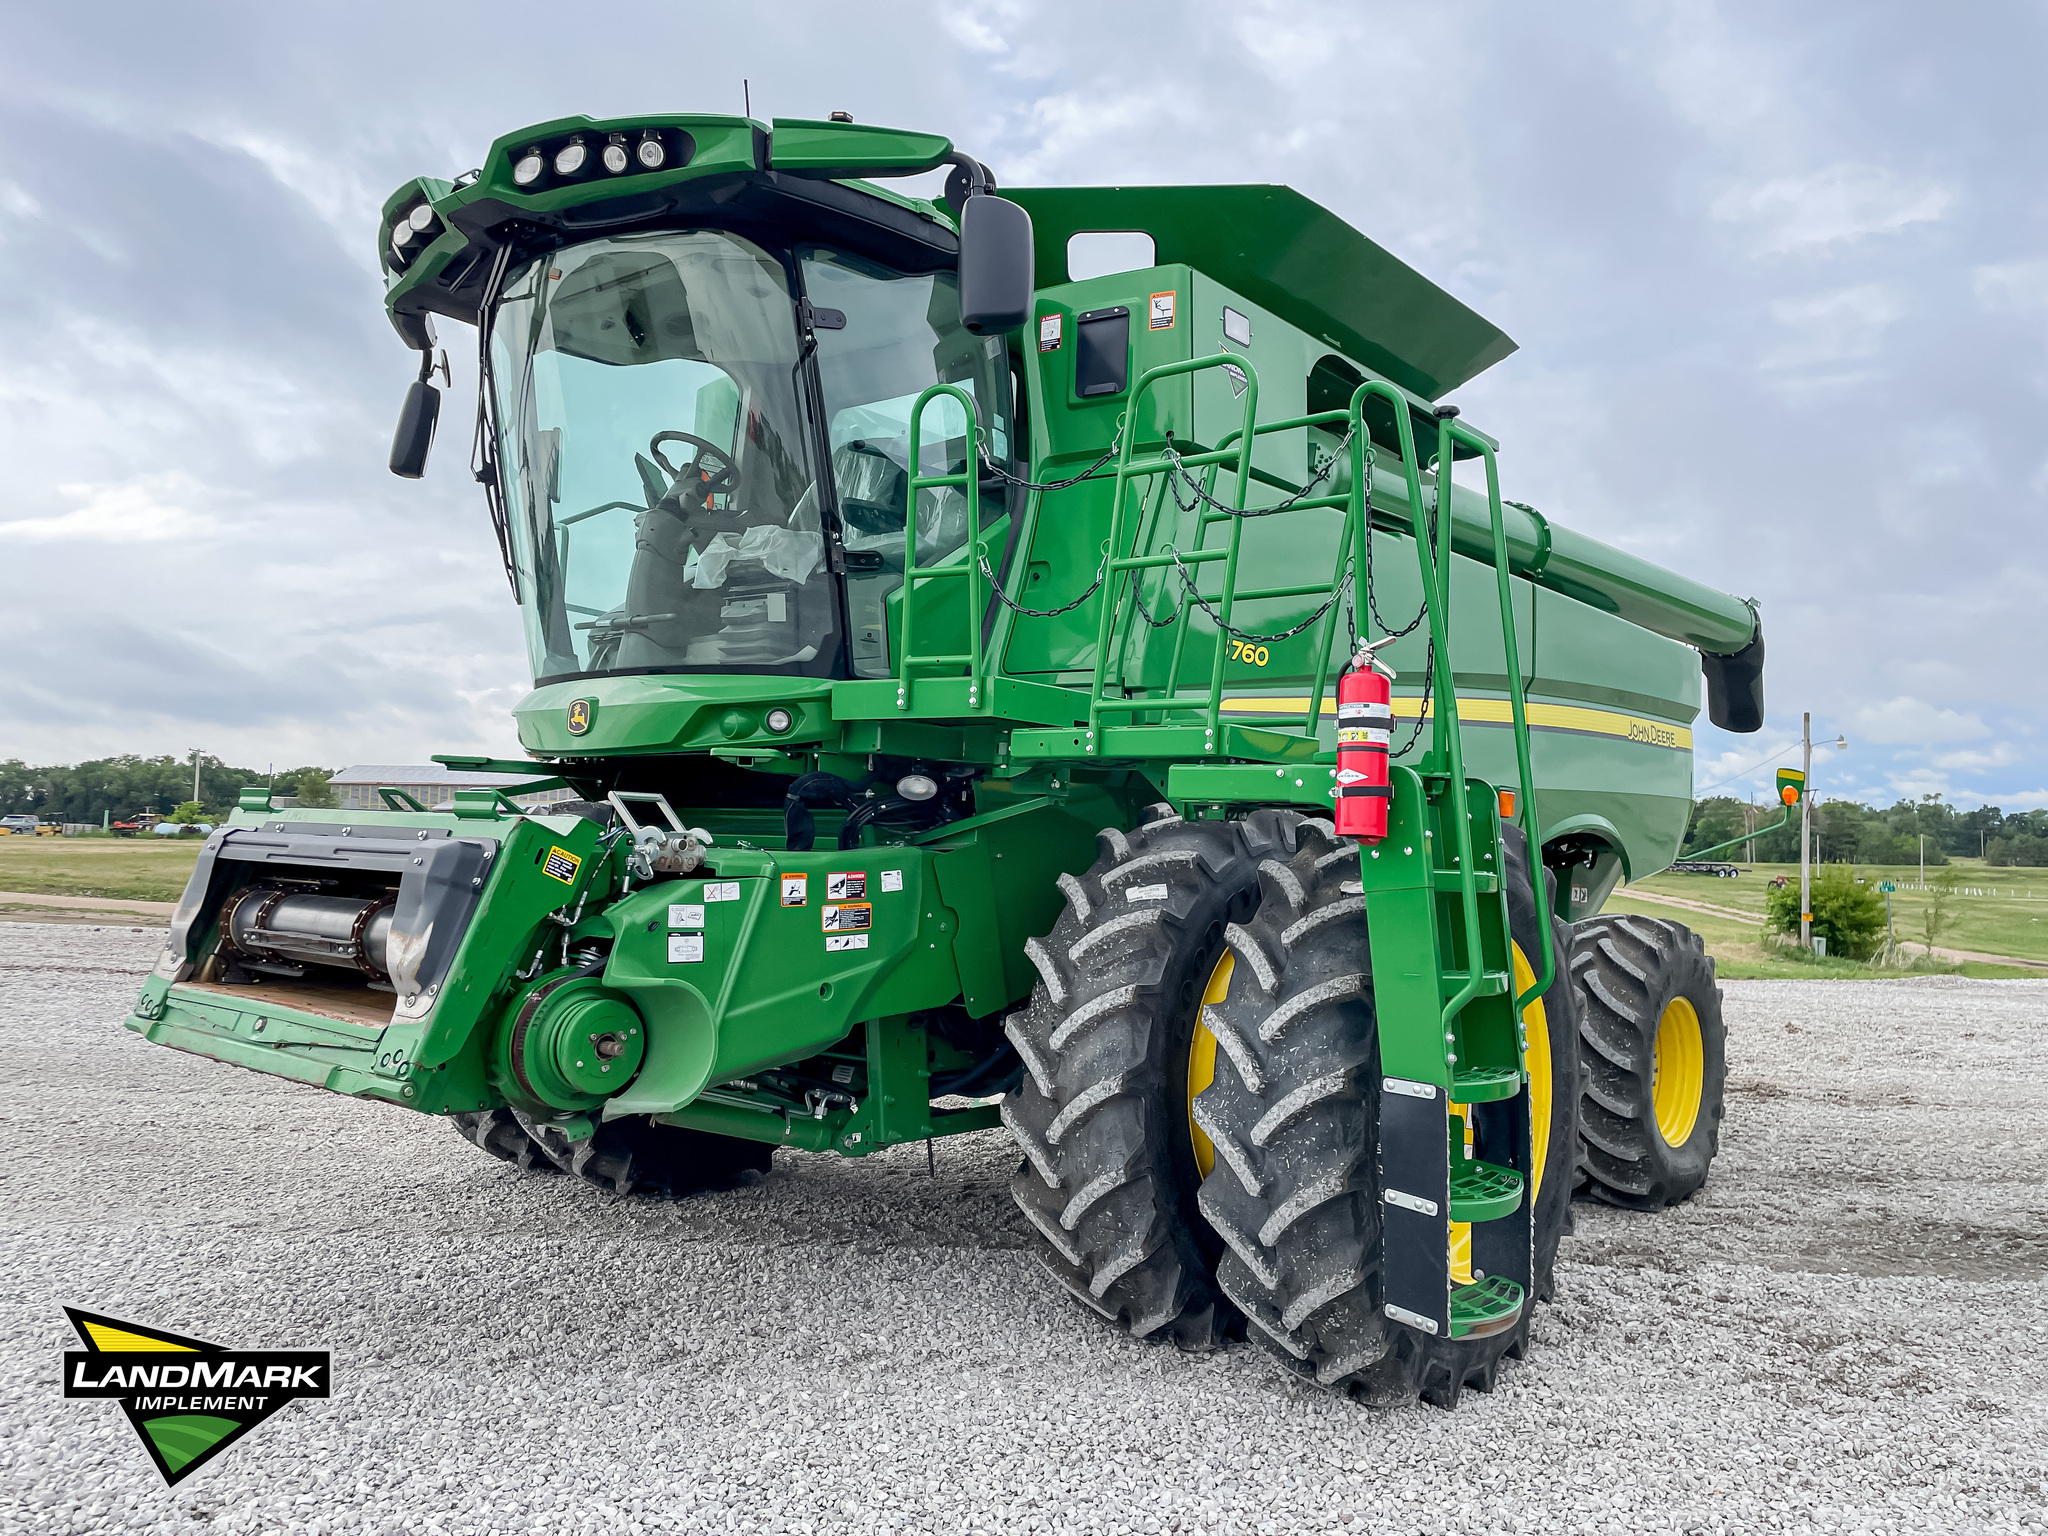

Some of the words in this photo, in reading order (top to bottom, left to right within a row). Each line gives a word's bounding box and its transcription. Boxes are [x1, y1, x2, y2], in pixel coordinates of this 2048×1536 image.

[1226, 639, 1269, 667] 760
[1628, 720, 1650, 741] JOHN
[1650, 725, 1676, 746] DEERE
[556, 849, 581, 864] CAUTION
